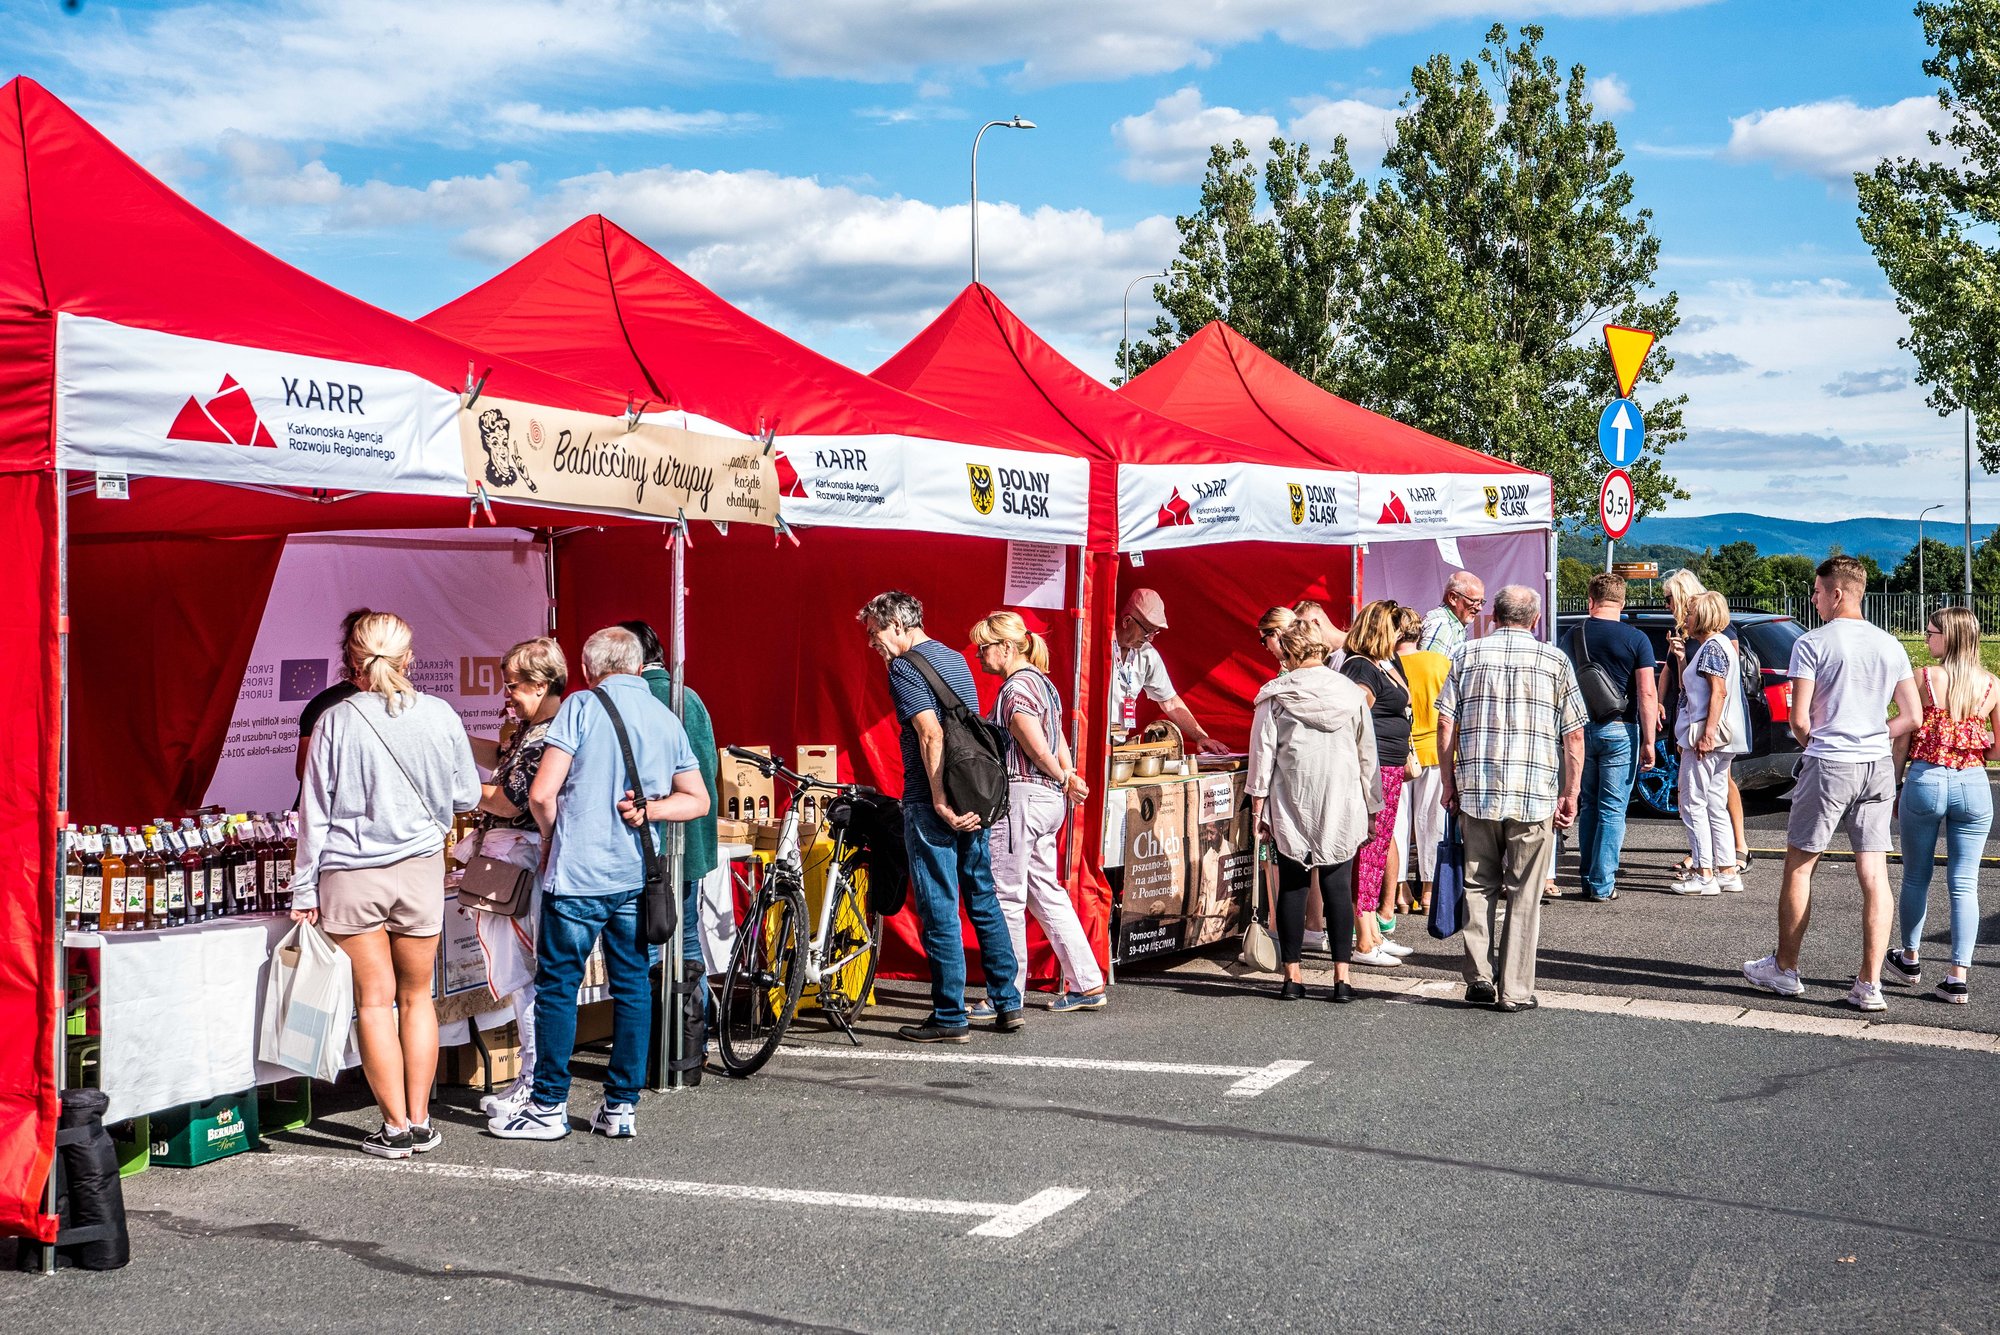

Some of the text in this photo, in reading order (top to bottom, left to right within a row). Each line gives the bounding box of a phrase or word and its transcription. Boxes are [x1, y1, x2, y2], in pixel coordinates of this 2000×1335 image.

[281, 376, 365, 415] KARR
[287, 422, 383, 445] Karkonoska Agencja
[289, 437, 396, 461] Rozwoju Regionalnego
[749, 455, 760, 470] do
[815, 448, 868, 472] KARR
[553, 429, 714, 513] Babiččiny sirupy
[998, 467, 1049, 493] DOLNY
[815, 478, 880, 493] Karkonoska Agencja
[1191, 478, 1227, 499] KARR
[1306, 485, 1338, 504] DOLNY
[1407, 487, 1437, 502] KARR
[1501, 485, 1530, 501] DOLNY
[816, 490, 886, 505] Rozwoju Regionalnego
[1002, 487, 1050, 519] ŚLĄSK
[1606, 489, 1628, 517] 3,5t
[1309, 500, 1339, 526] ŚLĄSK
[1500, 500, 1530, 517] ŚLĄSK
[1133, 826, 1180, 859] Chleb
[1135, 877, 1146, 885] na
[1132, 891, 1137, 899] z
[1130, 927, 1166, 941] Pomocne 80
[1129, 944, 1149, 956] 59-424
[207, 1119, 245, 1141] BERNARD
